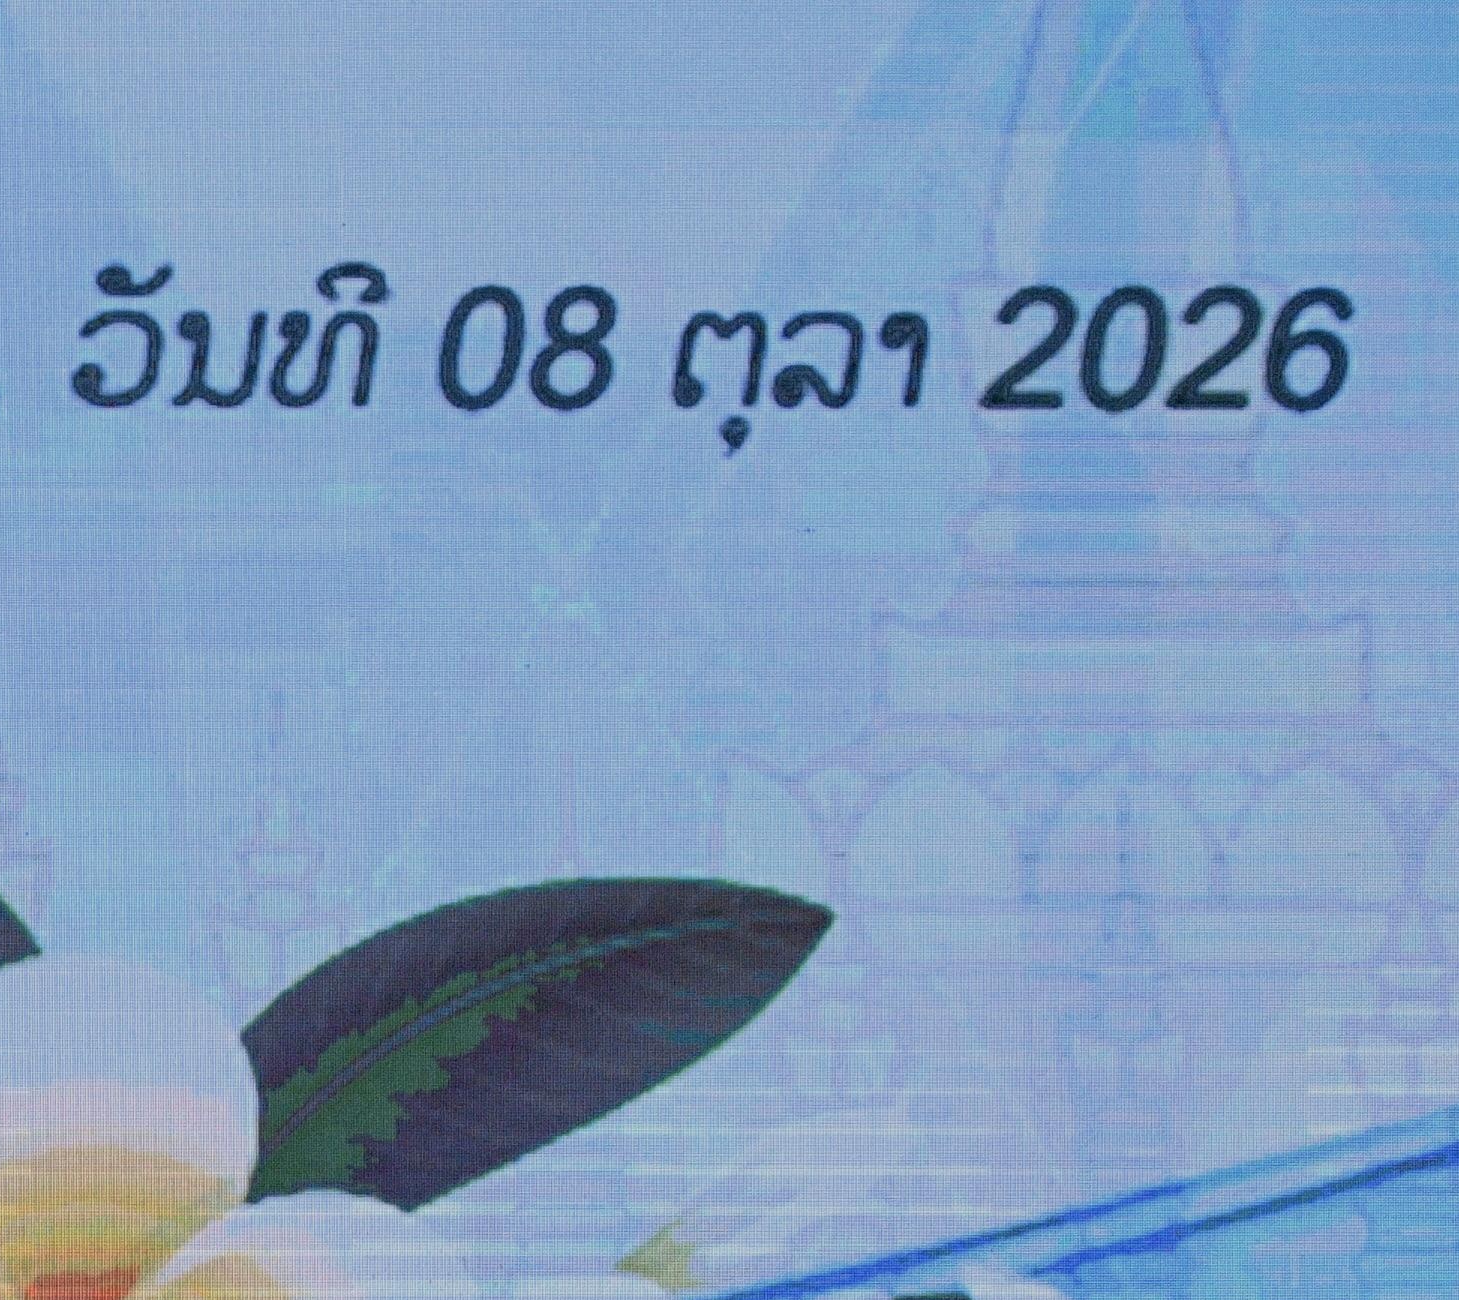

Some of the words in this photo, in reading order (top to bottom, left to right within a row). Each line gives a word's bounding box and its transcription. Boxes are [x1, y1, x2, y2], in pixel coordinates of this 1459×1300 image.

[437, 285, 617, 413] 08
[672, 311, 930, 451] ຕຸລາ
[980, 283, 1354, 414] 2026
